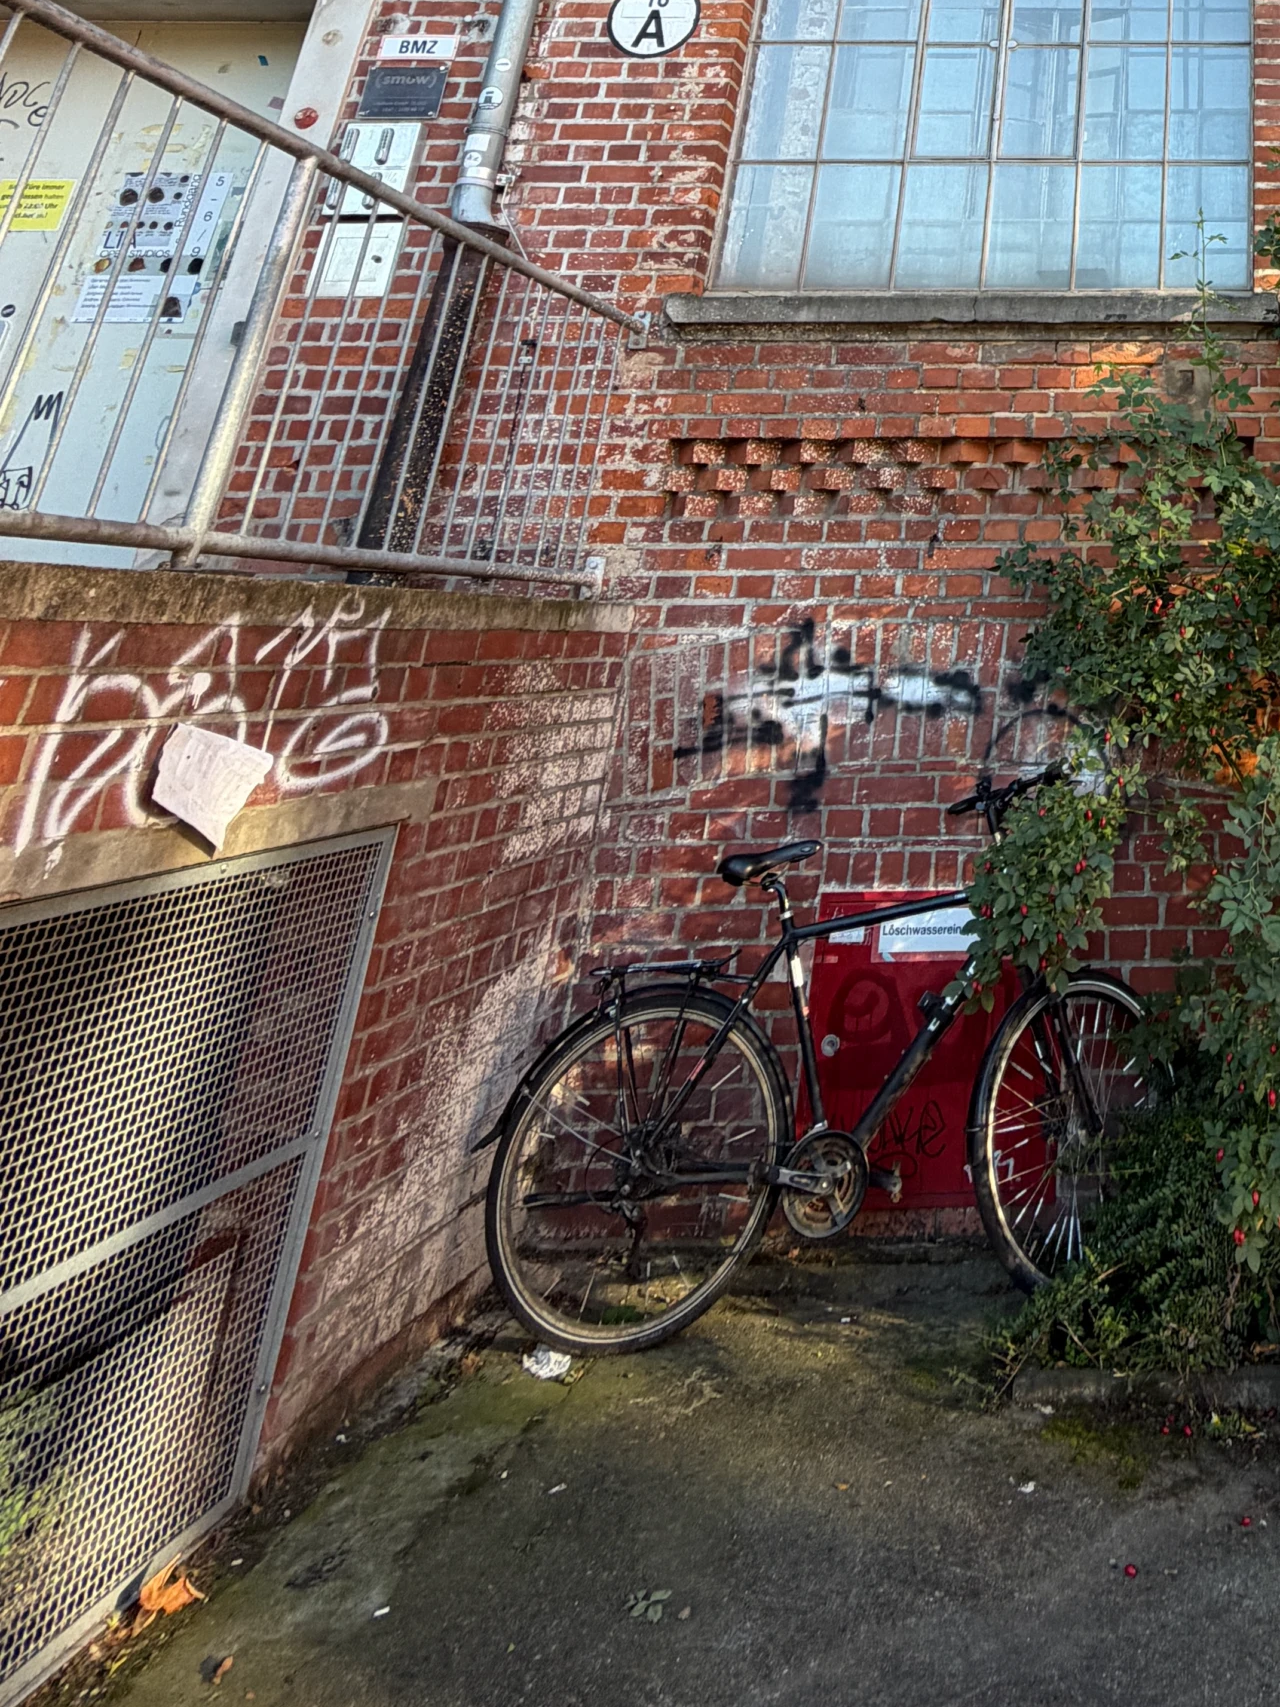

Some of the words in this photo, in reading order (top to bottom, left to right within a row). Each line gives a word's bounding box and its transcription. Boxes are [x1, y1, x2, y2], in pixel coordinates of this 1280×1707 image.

[630, 9, 665, 48] A
[398, 40, 438, 54] BMZ
[215, 176, 225, 187] 5
[203, 211, 213, 222] 6
[190, 246, 201, 257] 9
[882, 924, 962, 936] Löschwasserein
